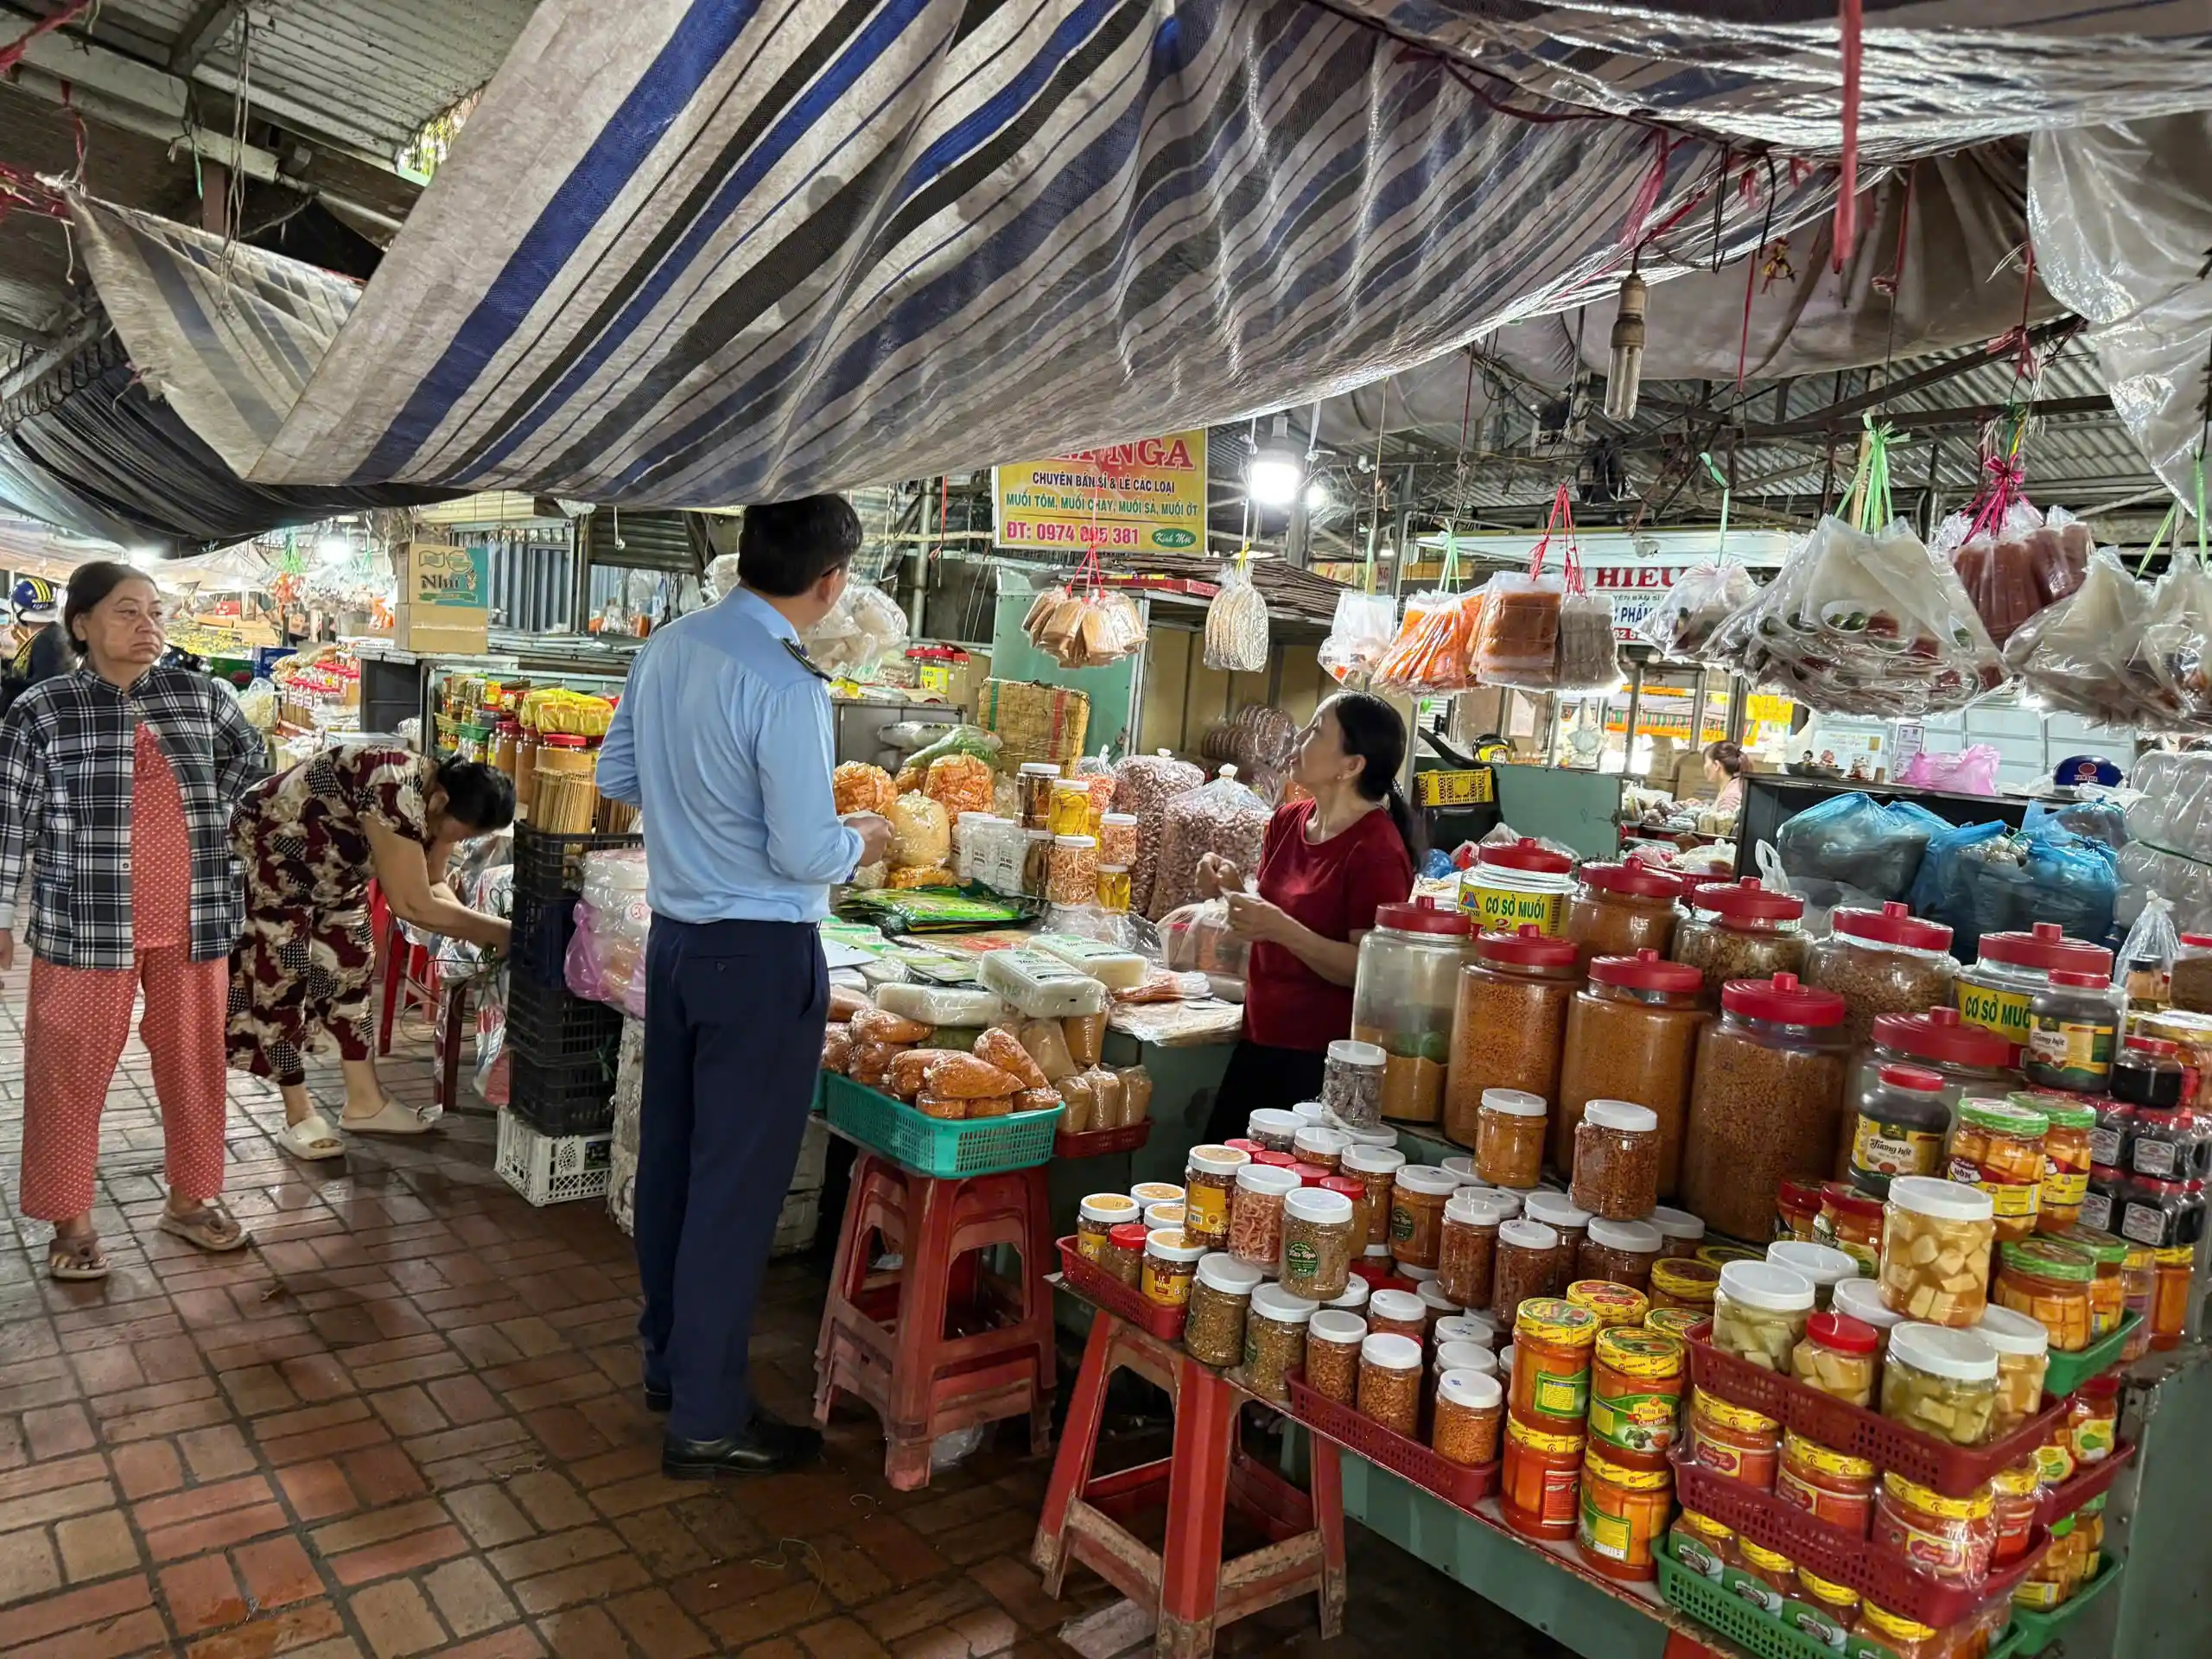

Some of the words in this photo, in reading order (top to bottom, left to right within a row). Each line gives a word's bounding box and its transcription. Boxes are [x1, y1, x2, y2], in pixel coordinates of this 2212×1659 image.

[1109, 438, 1195, 467] NGA
[1033, 472, 1072, 486] CHUYÊN
[1076, 473, 1095, 488] BÁN
[1109, 477, 1116, 489] &
[1120, 474, 1130, 490] LẺ
[1134, 475, 1152, 492] CÁC
[1154, 480, 1175, 496] LOẠI
[1006, 490, 1031, 506] MUỐI
[1034, 493, 1058, 512] TÔM,
[1061, 493, 1084, 510] MUỐI
[1118, 494, 1141, 513] MUỐI
[1161, 499, 1184, 518] MUỐI
[1007, 521, 1031, 539] ĐT:
[1037, 524, 1075, 542] 0974
[1113, 527, 1139, 545] 381
[1486, 895, 1499, 914] CƠ
[1502, 893, 1516, 916] SỞ
[1518, 895, 1544, 918] MUỐI
[1965, 995, 1980, 1018] CƠ
[1981, 994, 1999, 1022] SỞ
